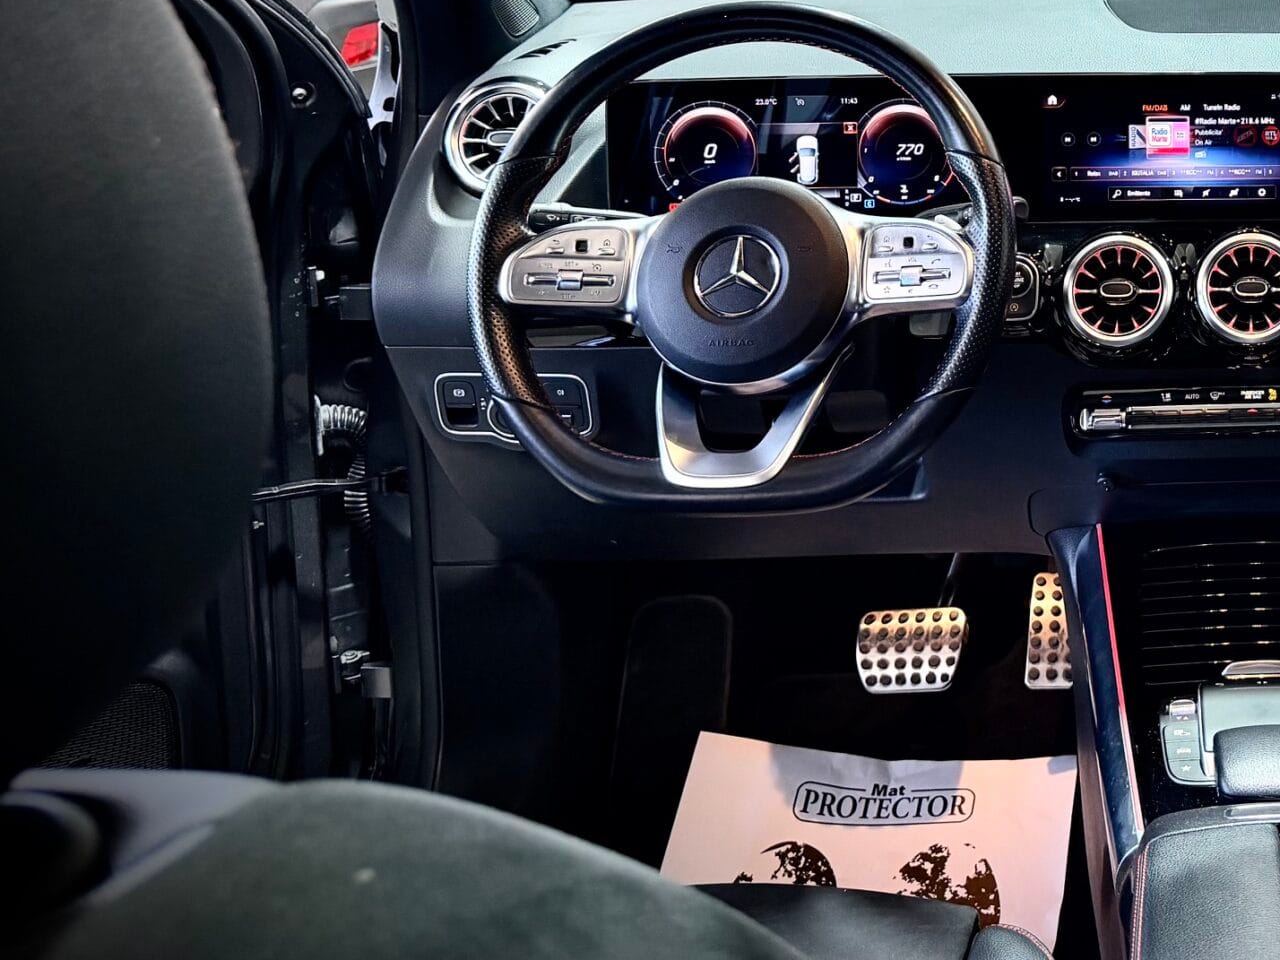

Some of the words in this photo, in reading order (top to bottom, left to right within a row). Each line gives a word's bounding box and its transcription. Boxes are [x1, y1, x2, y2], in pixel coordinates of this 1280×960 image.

[1179, 104, 1192, 112] AM
[1223, 104, 1241, 112] Radio
[703, 143, 718, 159] 0
[896, 143, 925, 156] 770
[871, 783, 906, 798] Mat
[799, 788, 967, 821] PROTECTOR
